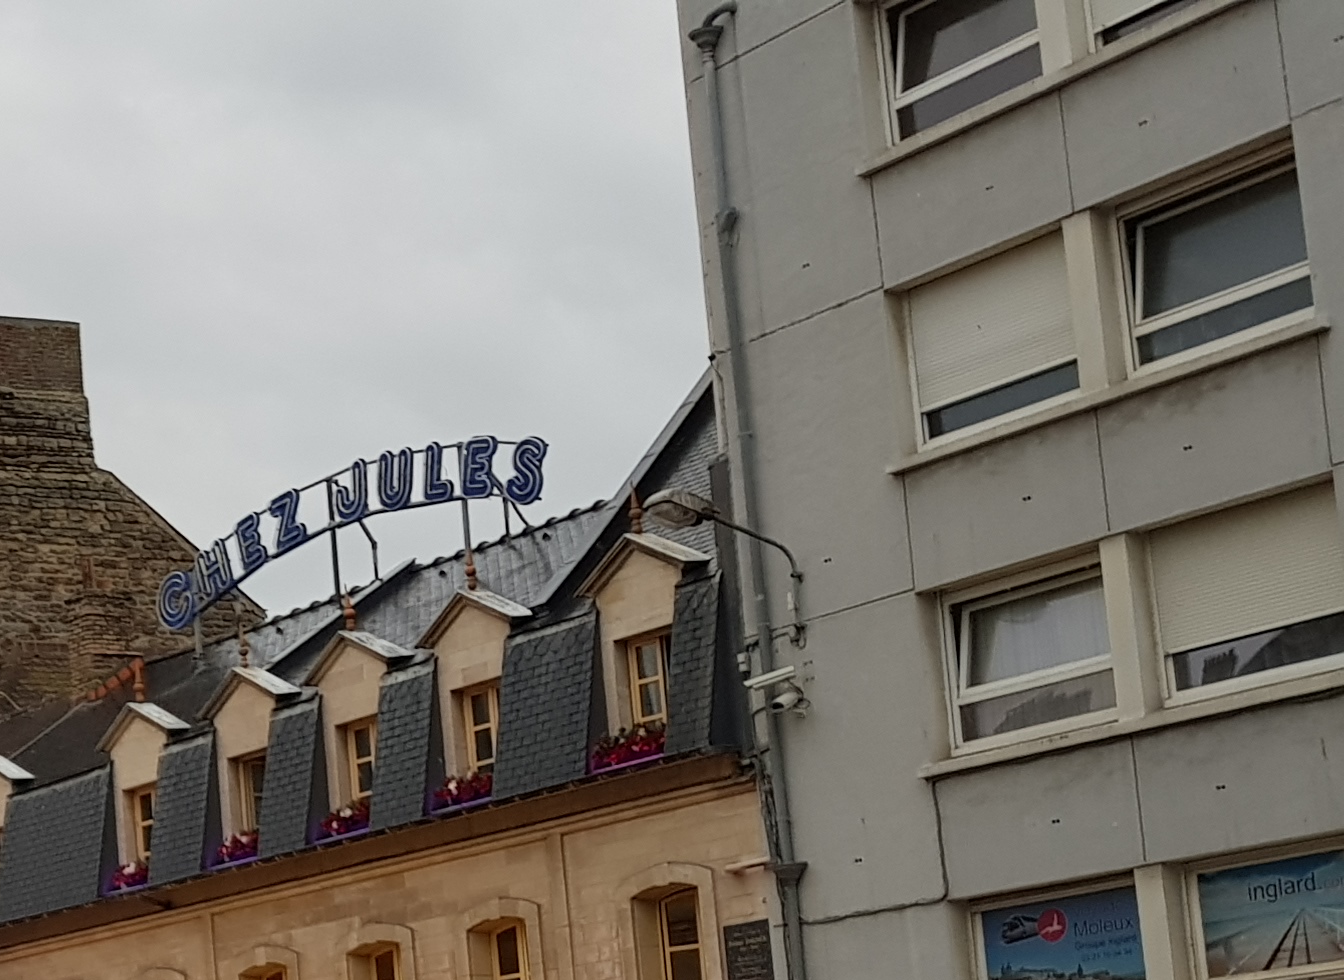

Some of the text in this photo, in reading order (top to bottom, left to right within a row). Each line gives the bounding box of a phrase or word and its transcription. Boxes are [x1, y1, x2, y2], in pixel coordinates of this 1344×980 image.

[156, 435, 549, 630] CHEZ JULES
[1073, 917, 1134, 937] Moleux
